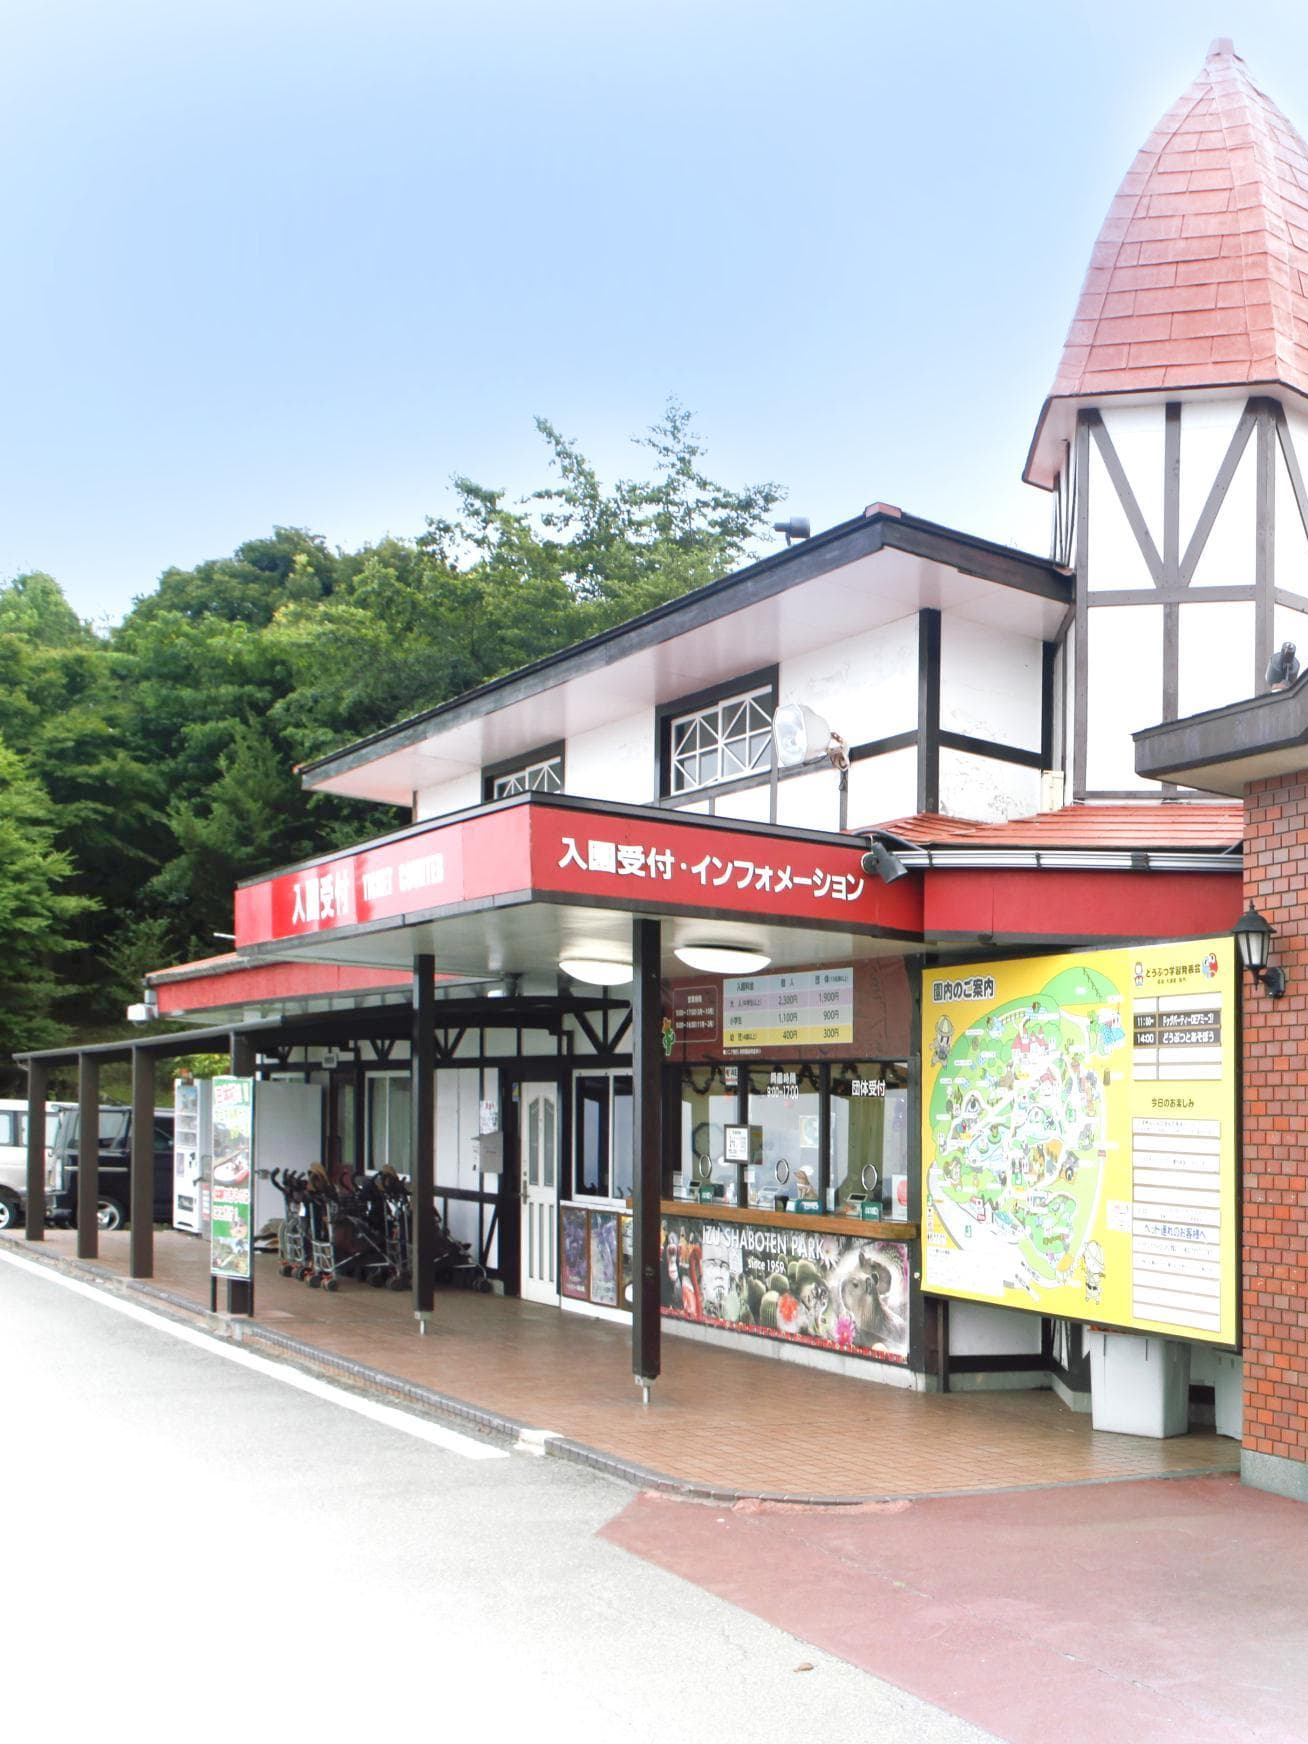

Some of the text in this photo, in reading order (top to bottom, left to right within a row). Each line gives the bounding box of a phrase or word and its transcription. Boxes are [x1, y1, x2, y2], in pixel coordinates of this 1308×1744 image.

[933, 978, 995, 1001] 園内のご案内
[851, 1079, 886, 1097] 団体受付
[702, 1224, 825, 1260] IZU SHABOTEN PARK
